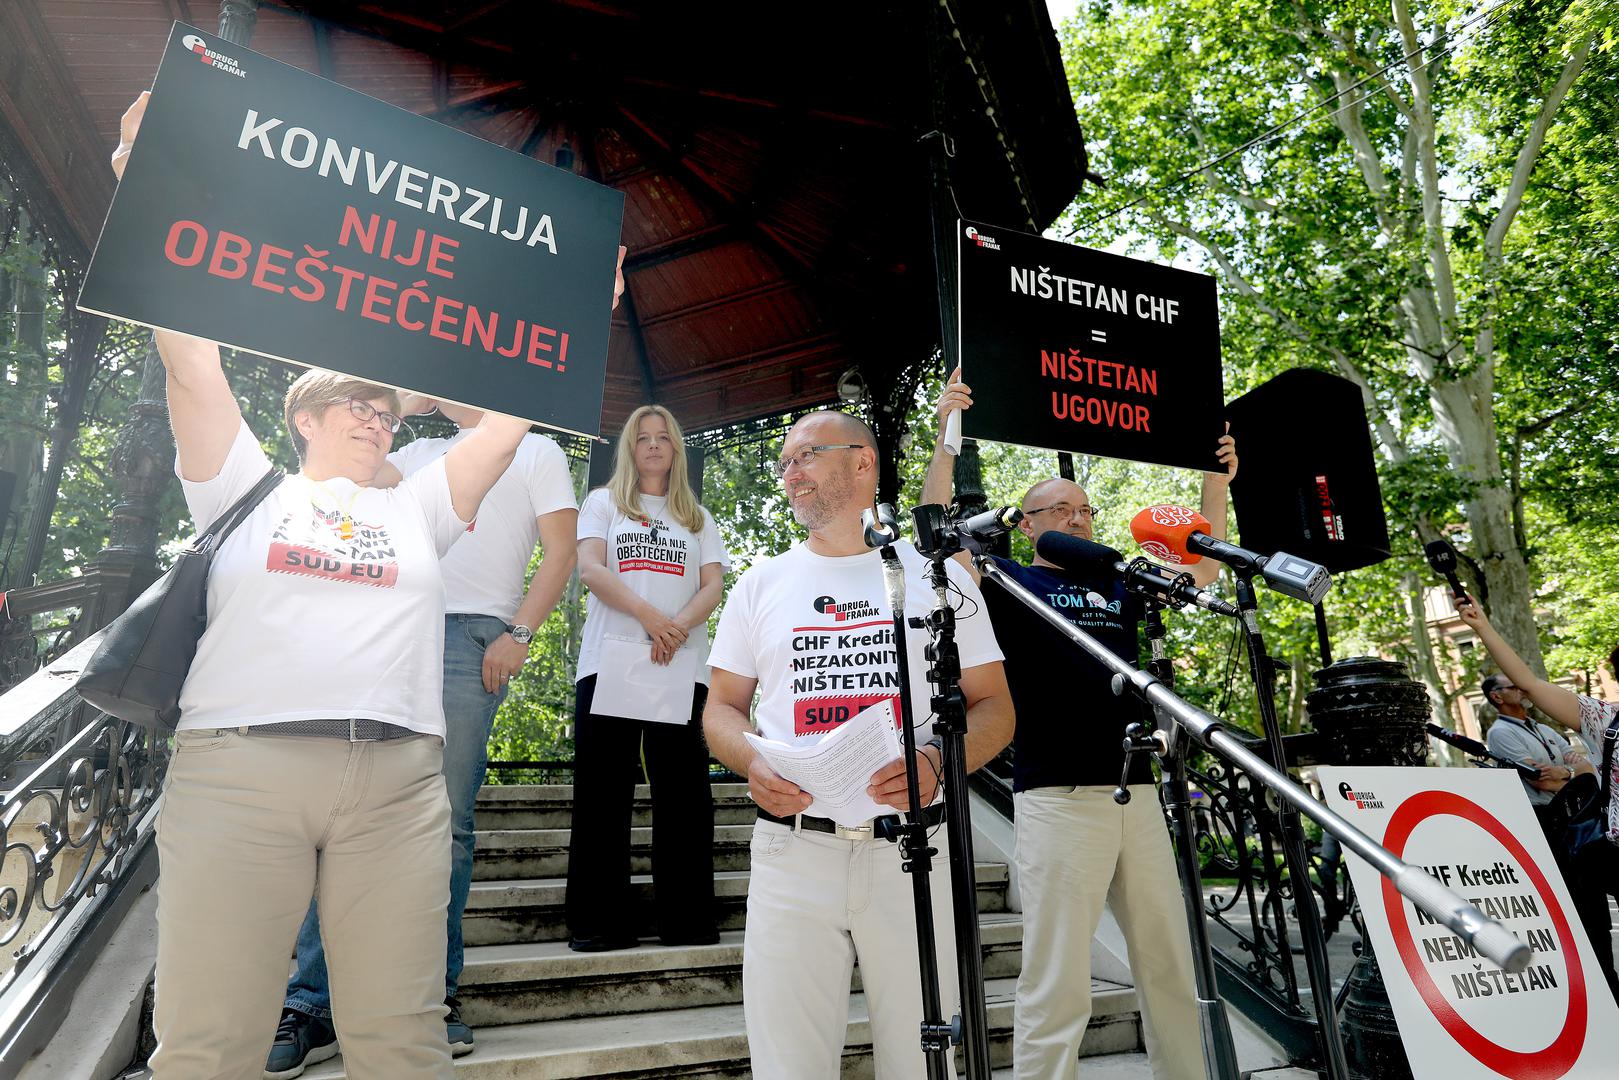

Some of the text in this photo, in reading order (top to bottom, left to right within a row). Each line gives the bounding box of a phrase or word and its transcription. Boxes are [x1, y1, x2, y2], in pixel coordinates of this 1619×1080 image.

[205, 49, 239, 68] UDRUGA
[212, 60, 247, 78] FRANAK
[237, 109, 558, 255] KONVERZIJA
[338, 205, 460, 279] NIJE
[164, 219, 569, 373] OBEŠTEĆENJE!
[1010, 265, 1179, 325] NIŠTETAN CHF
[1041, 348, 1158, 396] NIŠTETAN
[1052, 391, 1150, 433] UGOVOR
[616, 542, 687, 565] OBEŠTEĆENJE!
[669, 538, 687, 550] NIJE
[285, 551, 341, 573] SUD
[350, 563, 384, 579] EU
[836, 600, 869, 613] UDRUGA
[1046, 593, 1084, 608] TOM
[846, 607, 880, 621] FRANAK
[792, 635, 831, 651] CHF
[792, 650, 898, 672] NEZAKONIT
[793, 670, 900, 694] NIŠTETAN
[805, 705, 850, 725] SUD
[1419, 862, 1519, 887] HF Kredit
